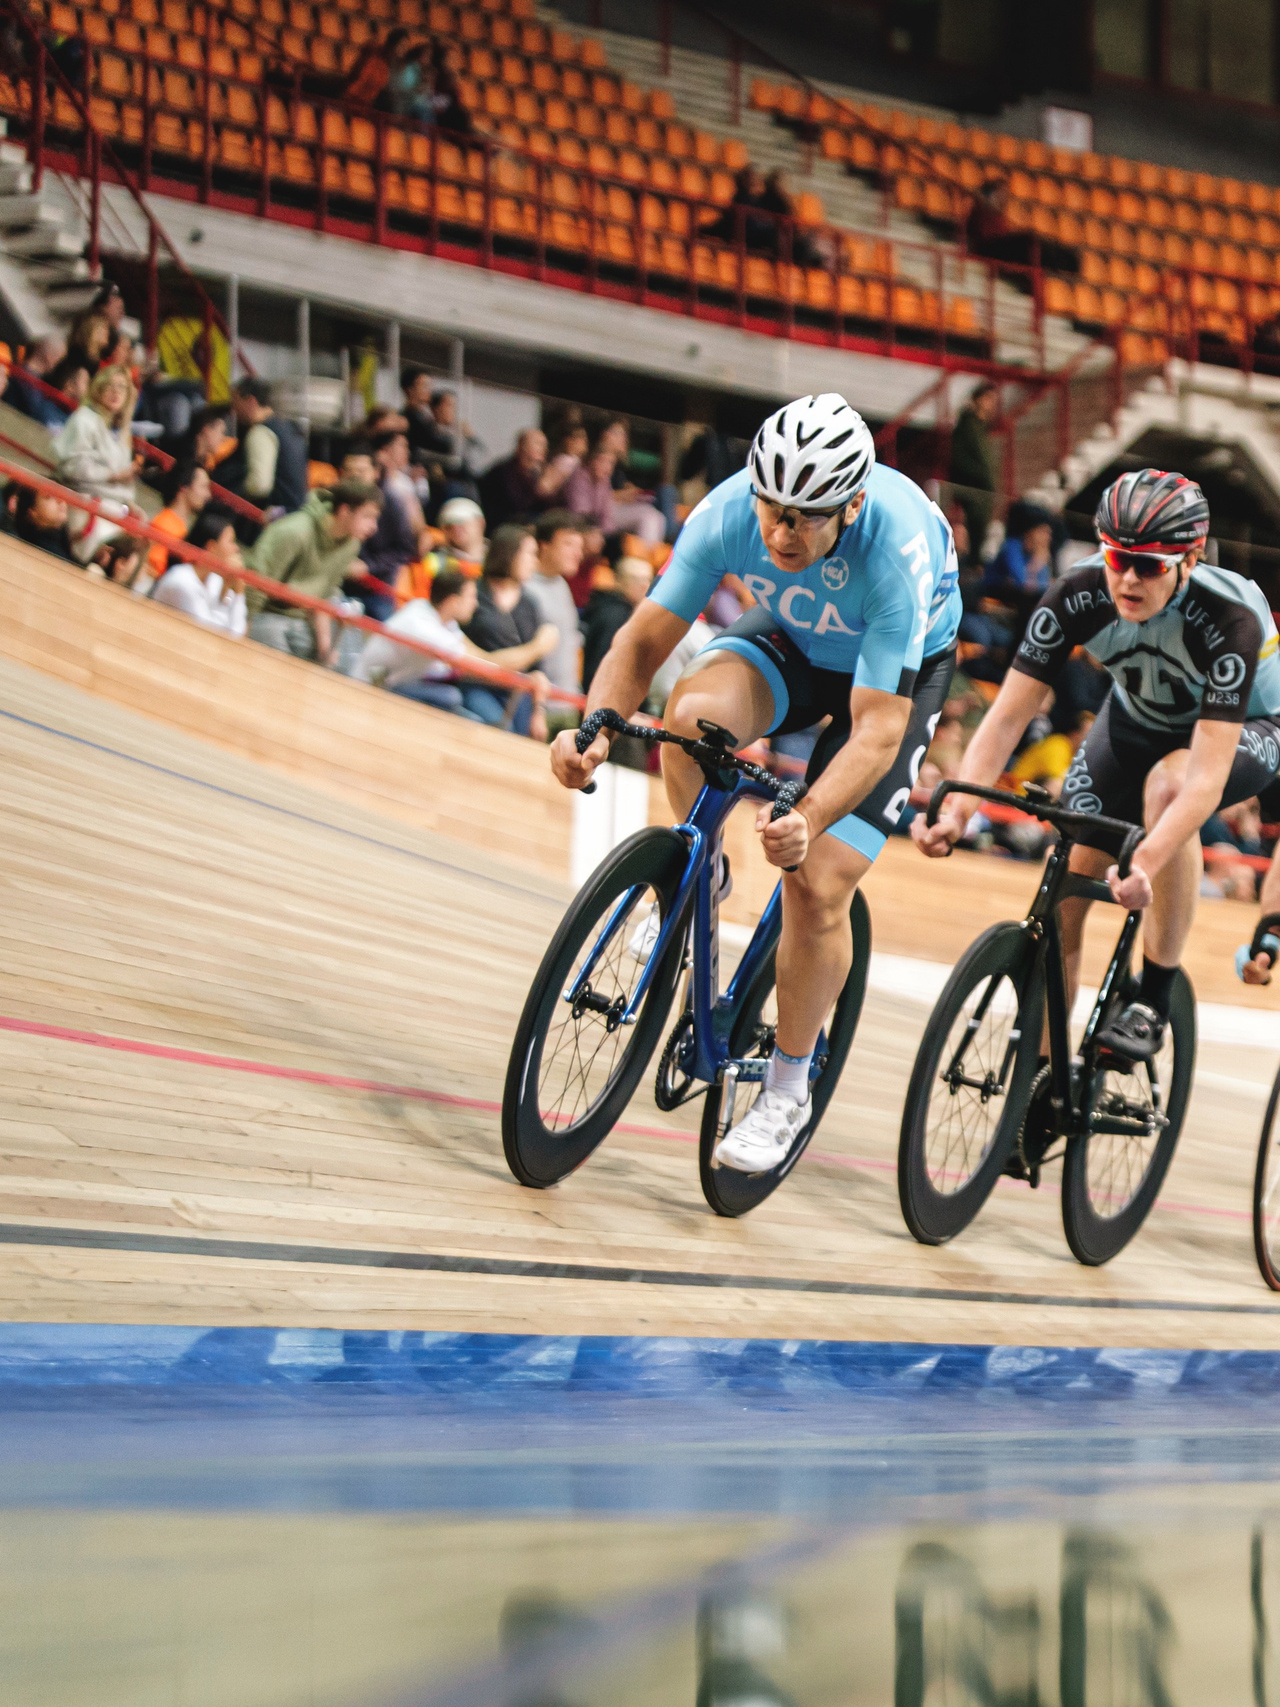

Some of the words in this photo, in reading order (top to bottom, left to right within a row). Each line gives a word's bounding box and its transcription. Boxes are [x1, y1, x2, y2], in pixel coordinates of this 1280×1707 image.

[743, 573, 863, 636] RCA
[1064, 588, 1115, 614] URA
[1019, 640, 1051, 664] U238
[1206, 691, 1241, 705] U238
